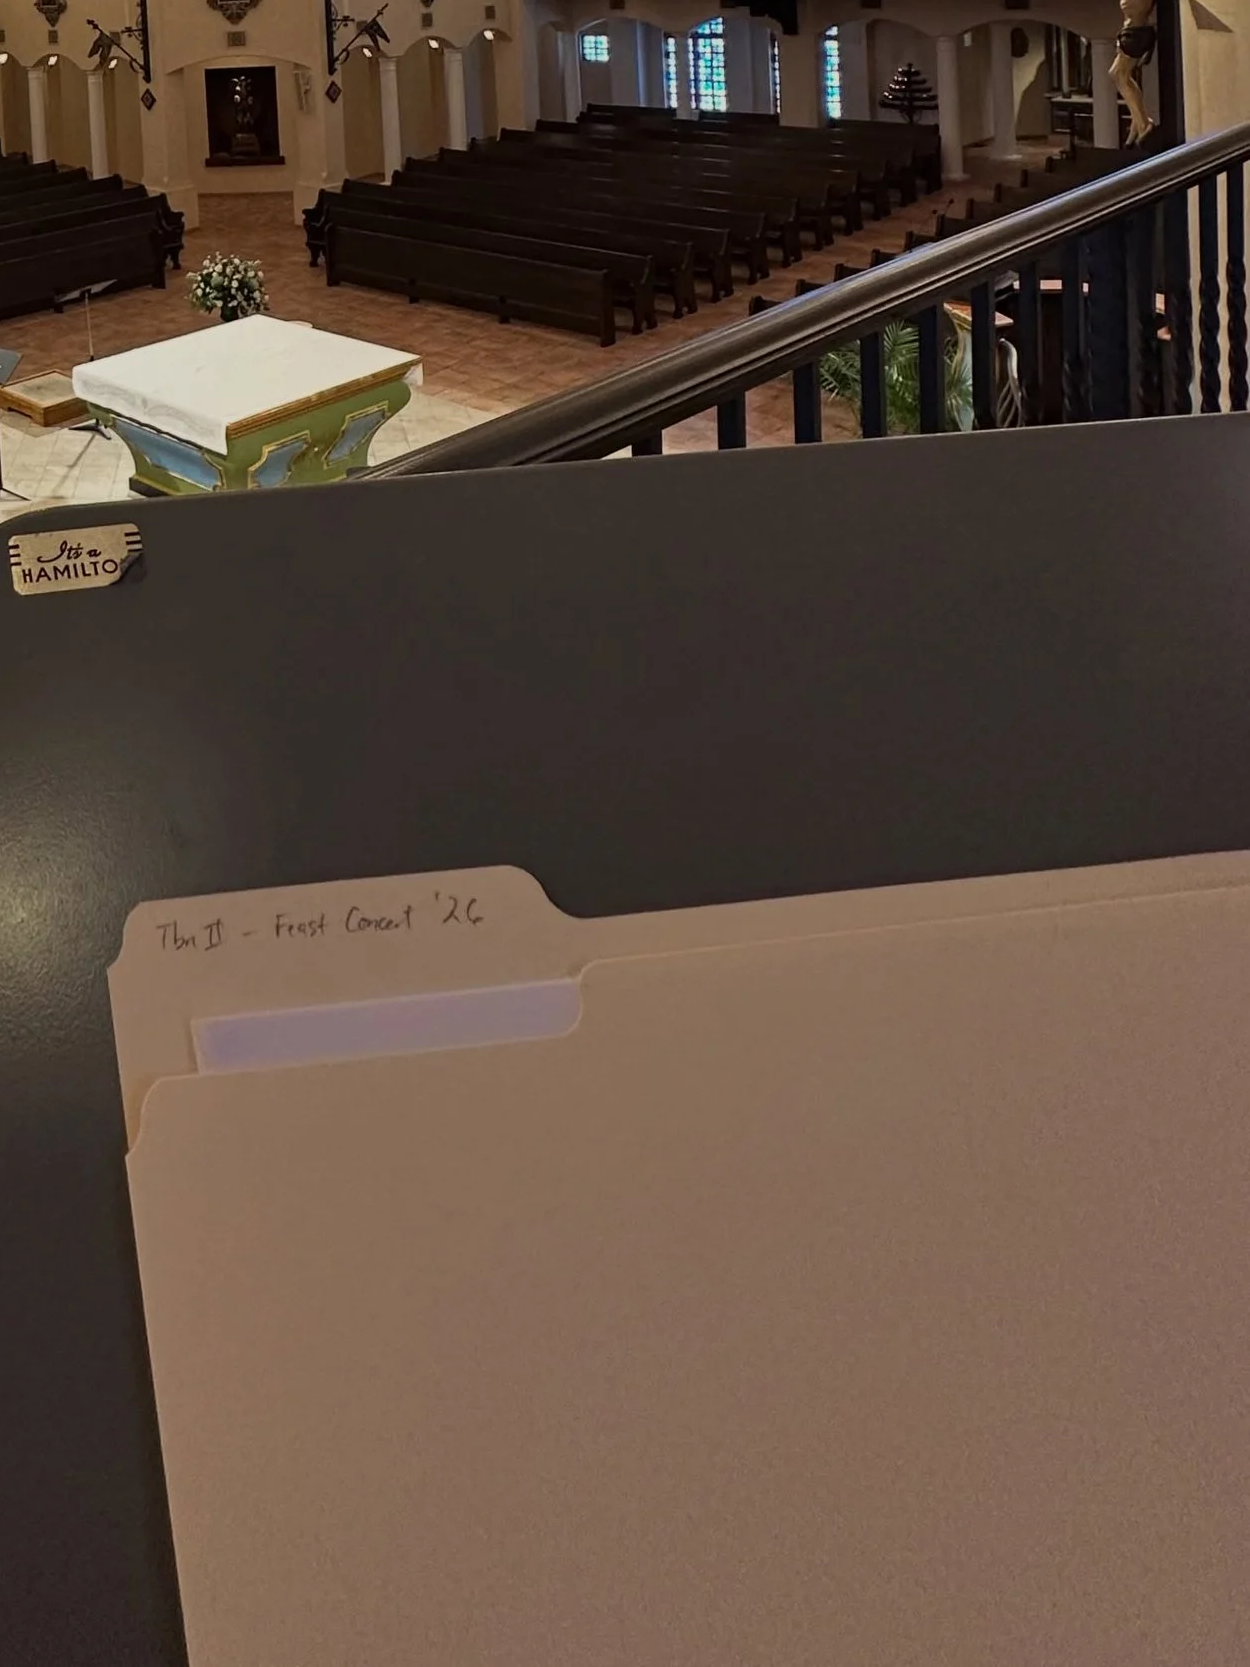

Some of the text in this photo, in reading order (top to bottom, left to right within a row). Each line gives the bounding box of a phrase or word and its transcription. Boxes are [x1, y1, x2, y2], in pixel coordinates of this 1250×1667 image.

[37, 540, 102, 563] It's a
[22, 559, 118, 583] HAMILTO
[156, 920, 196, 951] Tbn
[275, 913, 326, 938] Feast
